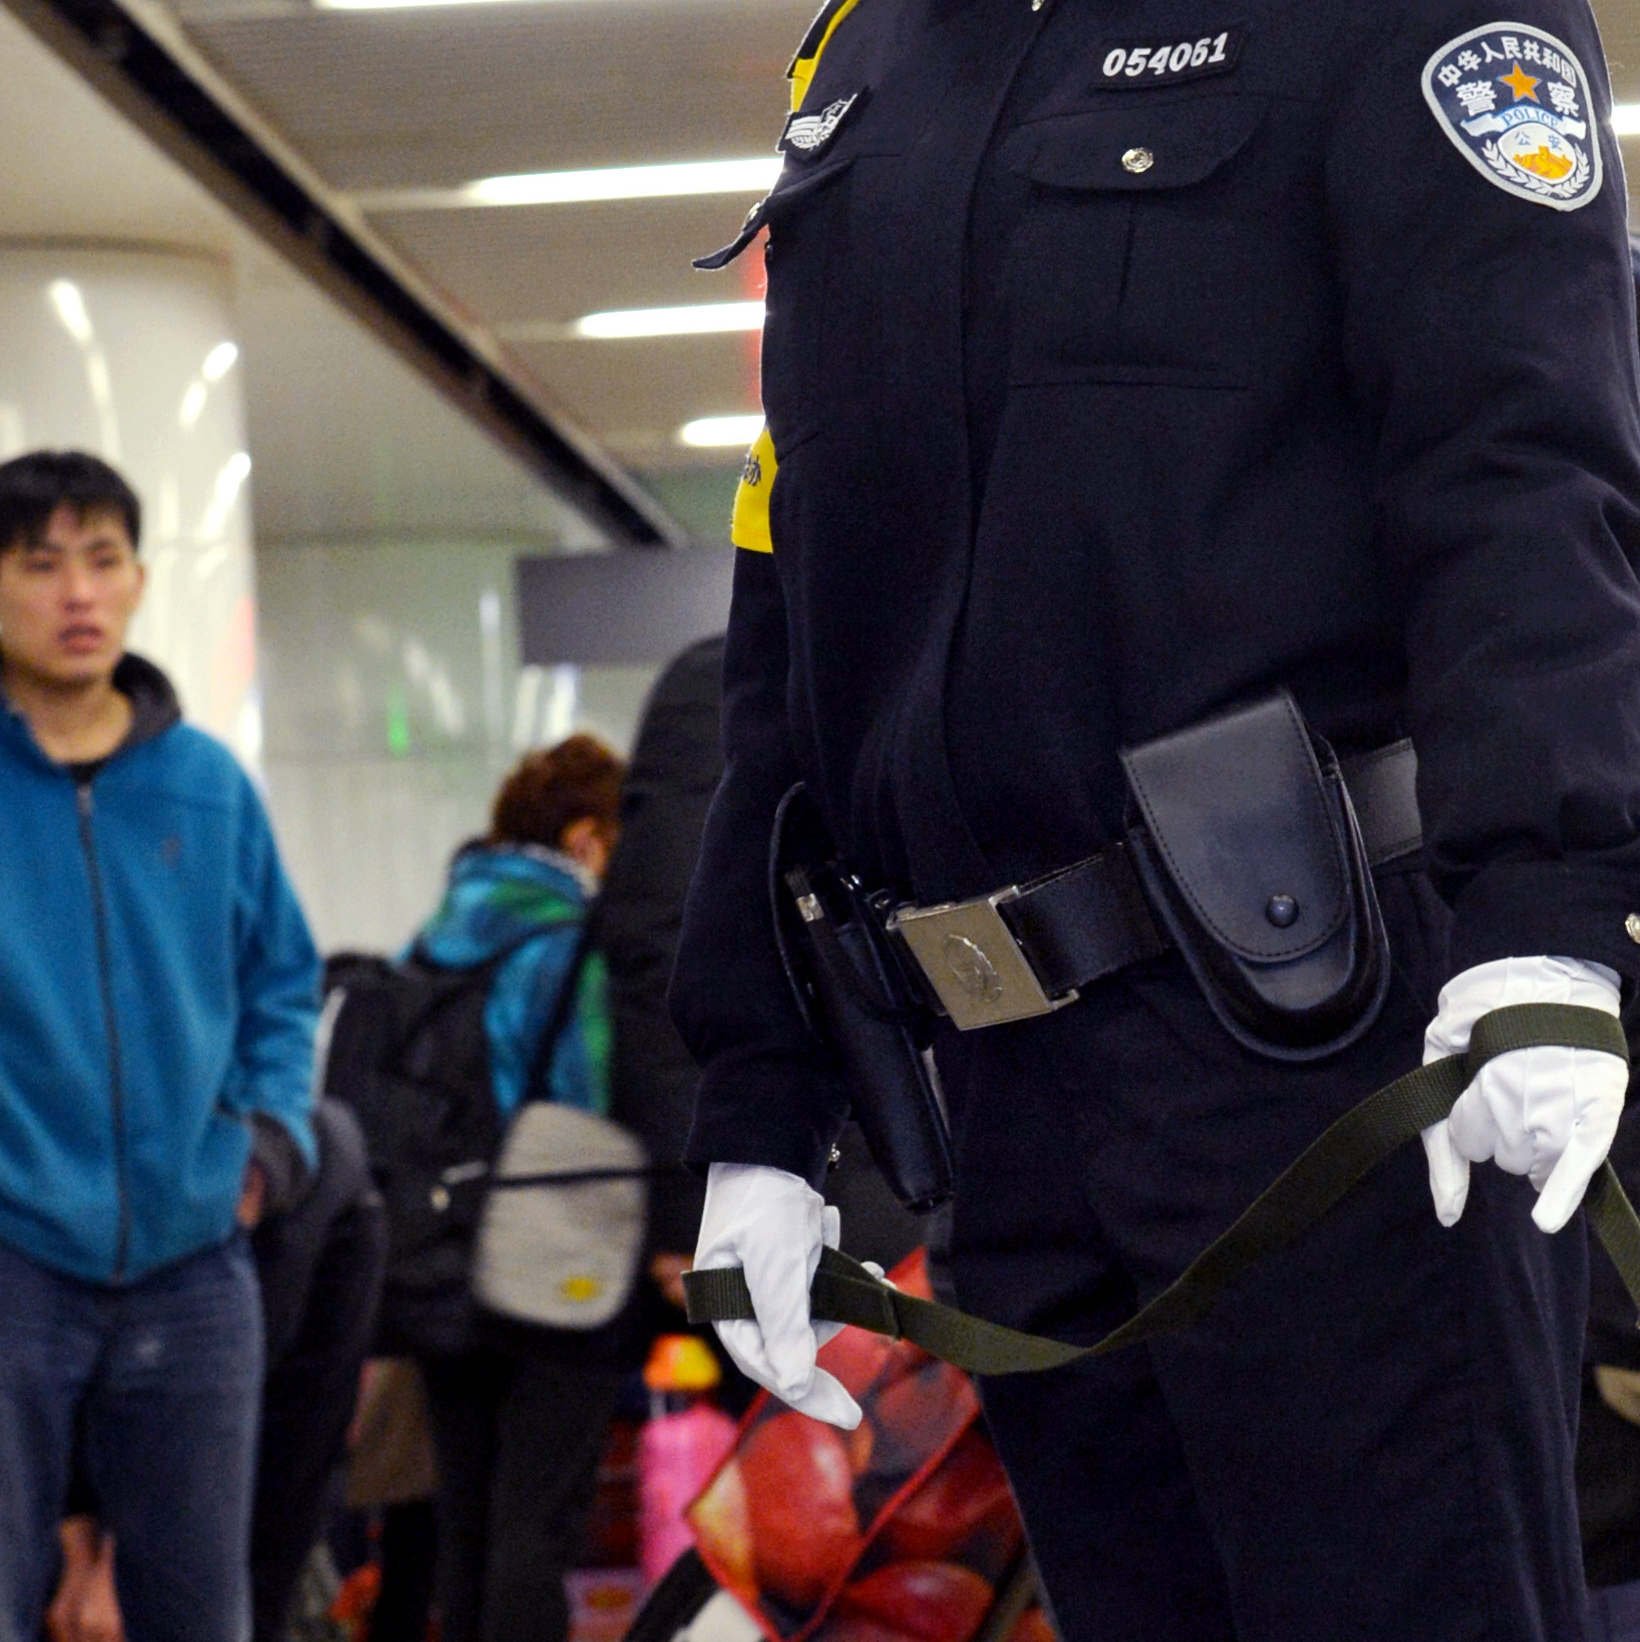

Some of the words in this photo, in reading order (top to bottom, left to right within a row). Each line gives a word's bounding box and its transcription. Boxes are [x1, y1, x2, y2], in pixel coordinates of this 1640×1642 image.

[1102, 32, 1228, 77] 054061
[1437, 36, 1577, 88] 中华人民共和国
[1501, 108, 1558, 127] POLICE
